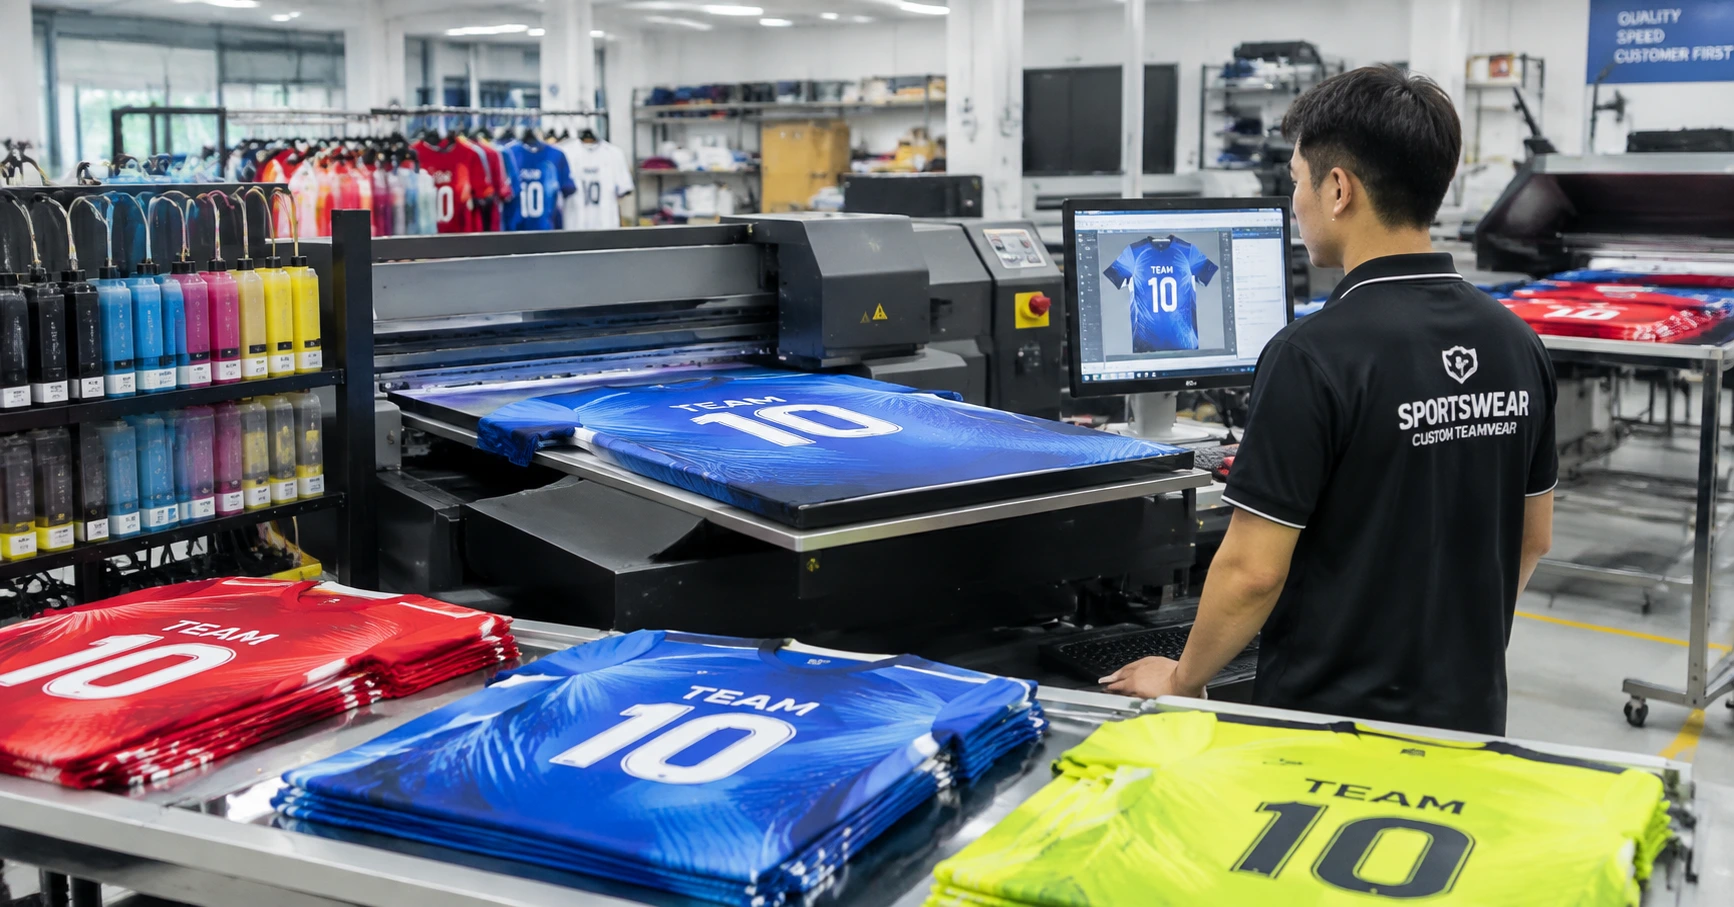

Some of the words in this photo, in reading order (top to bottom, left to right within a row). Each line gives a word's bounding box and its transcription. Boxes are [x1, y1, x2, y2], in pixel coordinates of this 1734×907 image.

[1617, 8, 1682, 27] QUALITY
[1616, 28, 1666, 45] SPEED
[1614, 46, 1690, 64] CUSTOMER
[1692, 45, 1734, 61] FIRST
[520, 181, 544, 218] 10
[1150, 265, 1174, 275] TEAM
[1147, 276, 1178, 313] 10
[669, 395, 787, 413] TEAM
[1398, 390, 1530, 431] SPORTSWEAR
[690, 404, 904, 447] 10
[1412, 427, 1454, 447] CUSTOM
[162, 619, 280, 646] TEAM
[0, 633, 237, 700] 10
[682, 685, 820, 717] TEAM
[549, 702, 797, 785] 10
[1305, 778, 1466, 815] TEAM
[1229, 801, 1477, 900] 10
